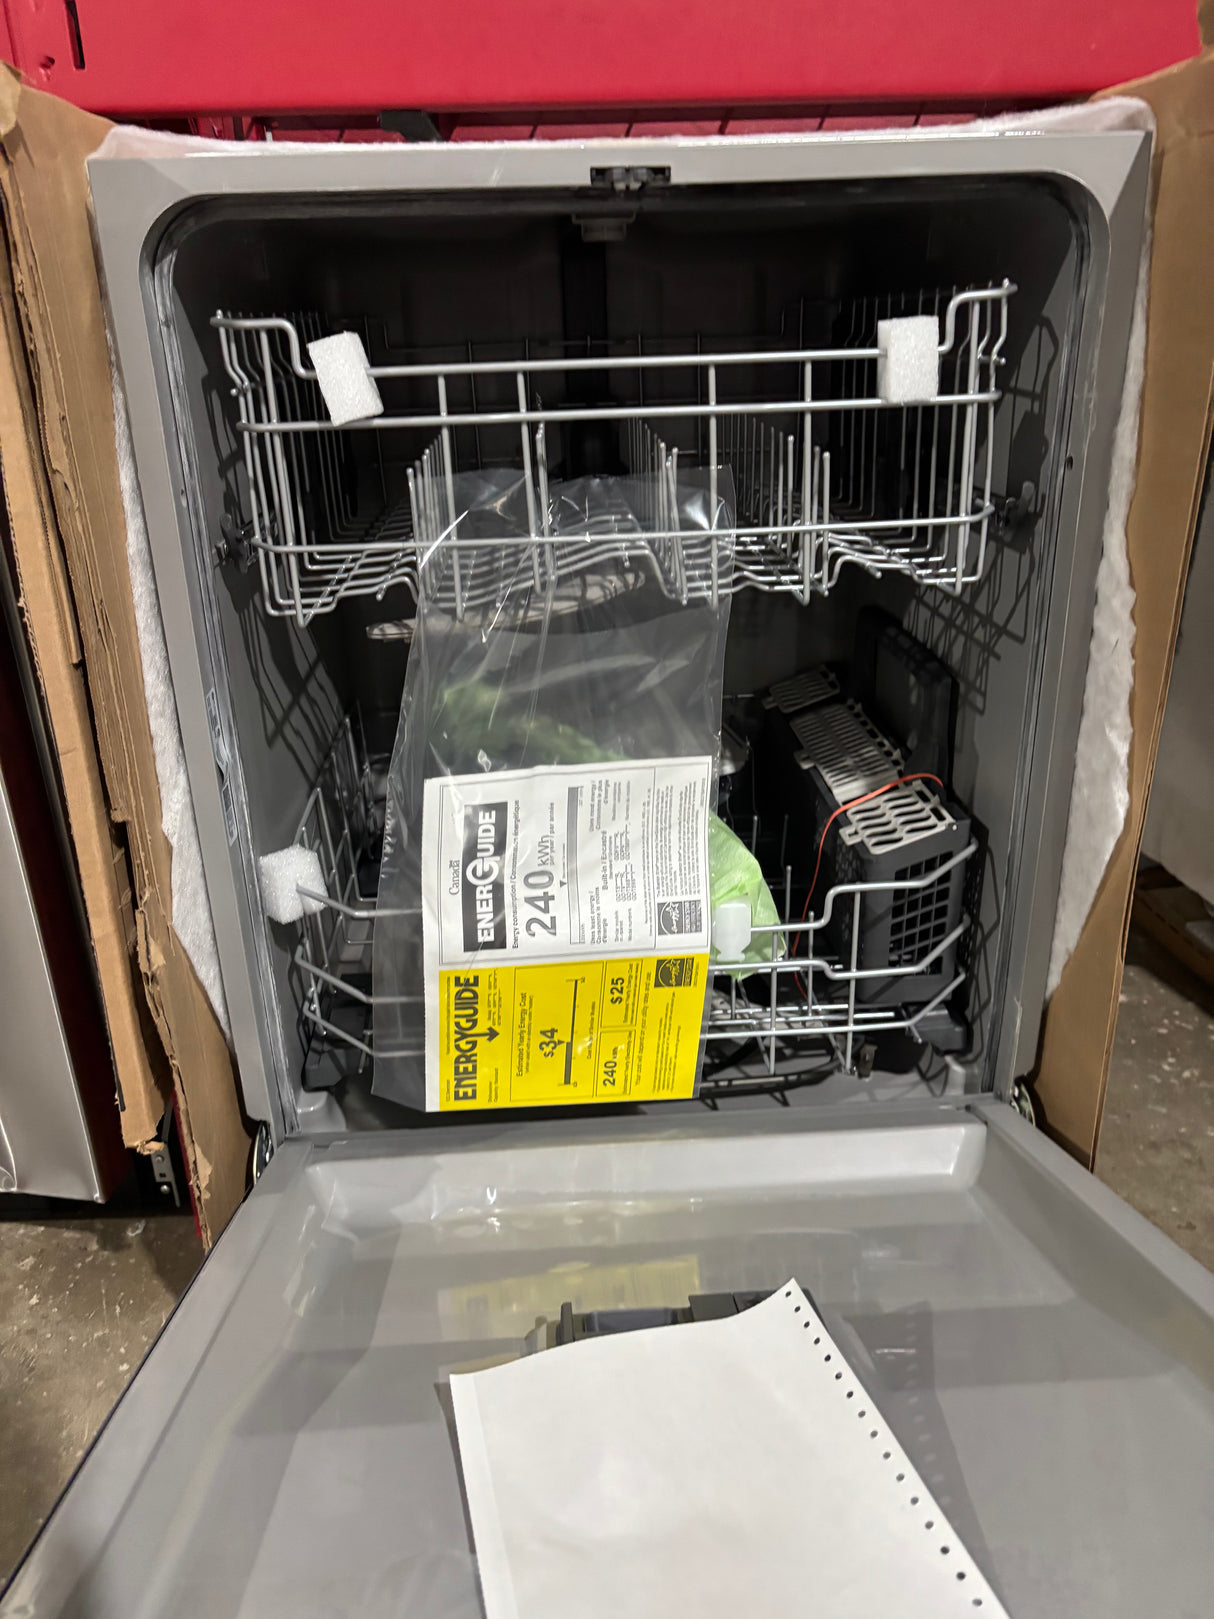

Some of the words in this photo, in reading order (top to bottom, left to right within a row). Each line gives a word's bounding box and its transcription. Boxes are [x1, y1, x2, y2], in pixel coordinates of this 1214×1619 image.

[537, 835, 550, 866] kWh
[449, 860, 459, 895] Canada
[466, 811, 500, 942] ENERGUIDE
[523, 871, 556, 937] 240
[610, 978, 624, 1005] $25
[518, 1009, 527, 1028] Energy
[454, 976, 480, 1101] ENERGYGUIDE
[518, 1030, 526, 1047] Yearly
[538, 1028, 558, 1058] $34
[602, 1061, 617, 1086] 240
